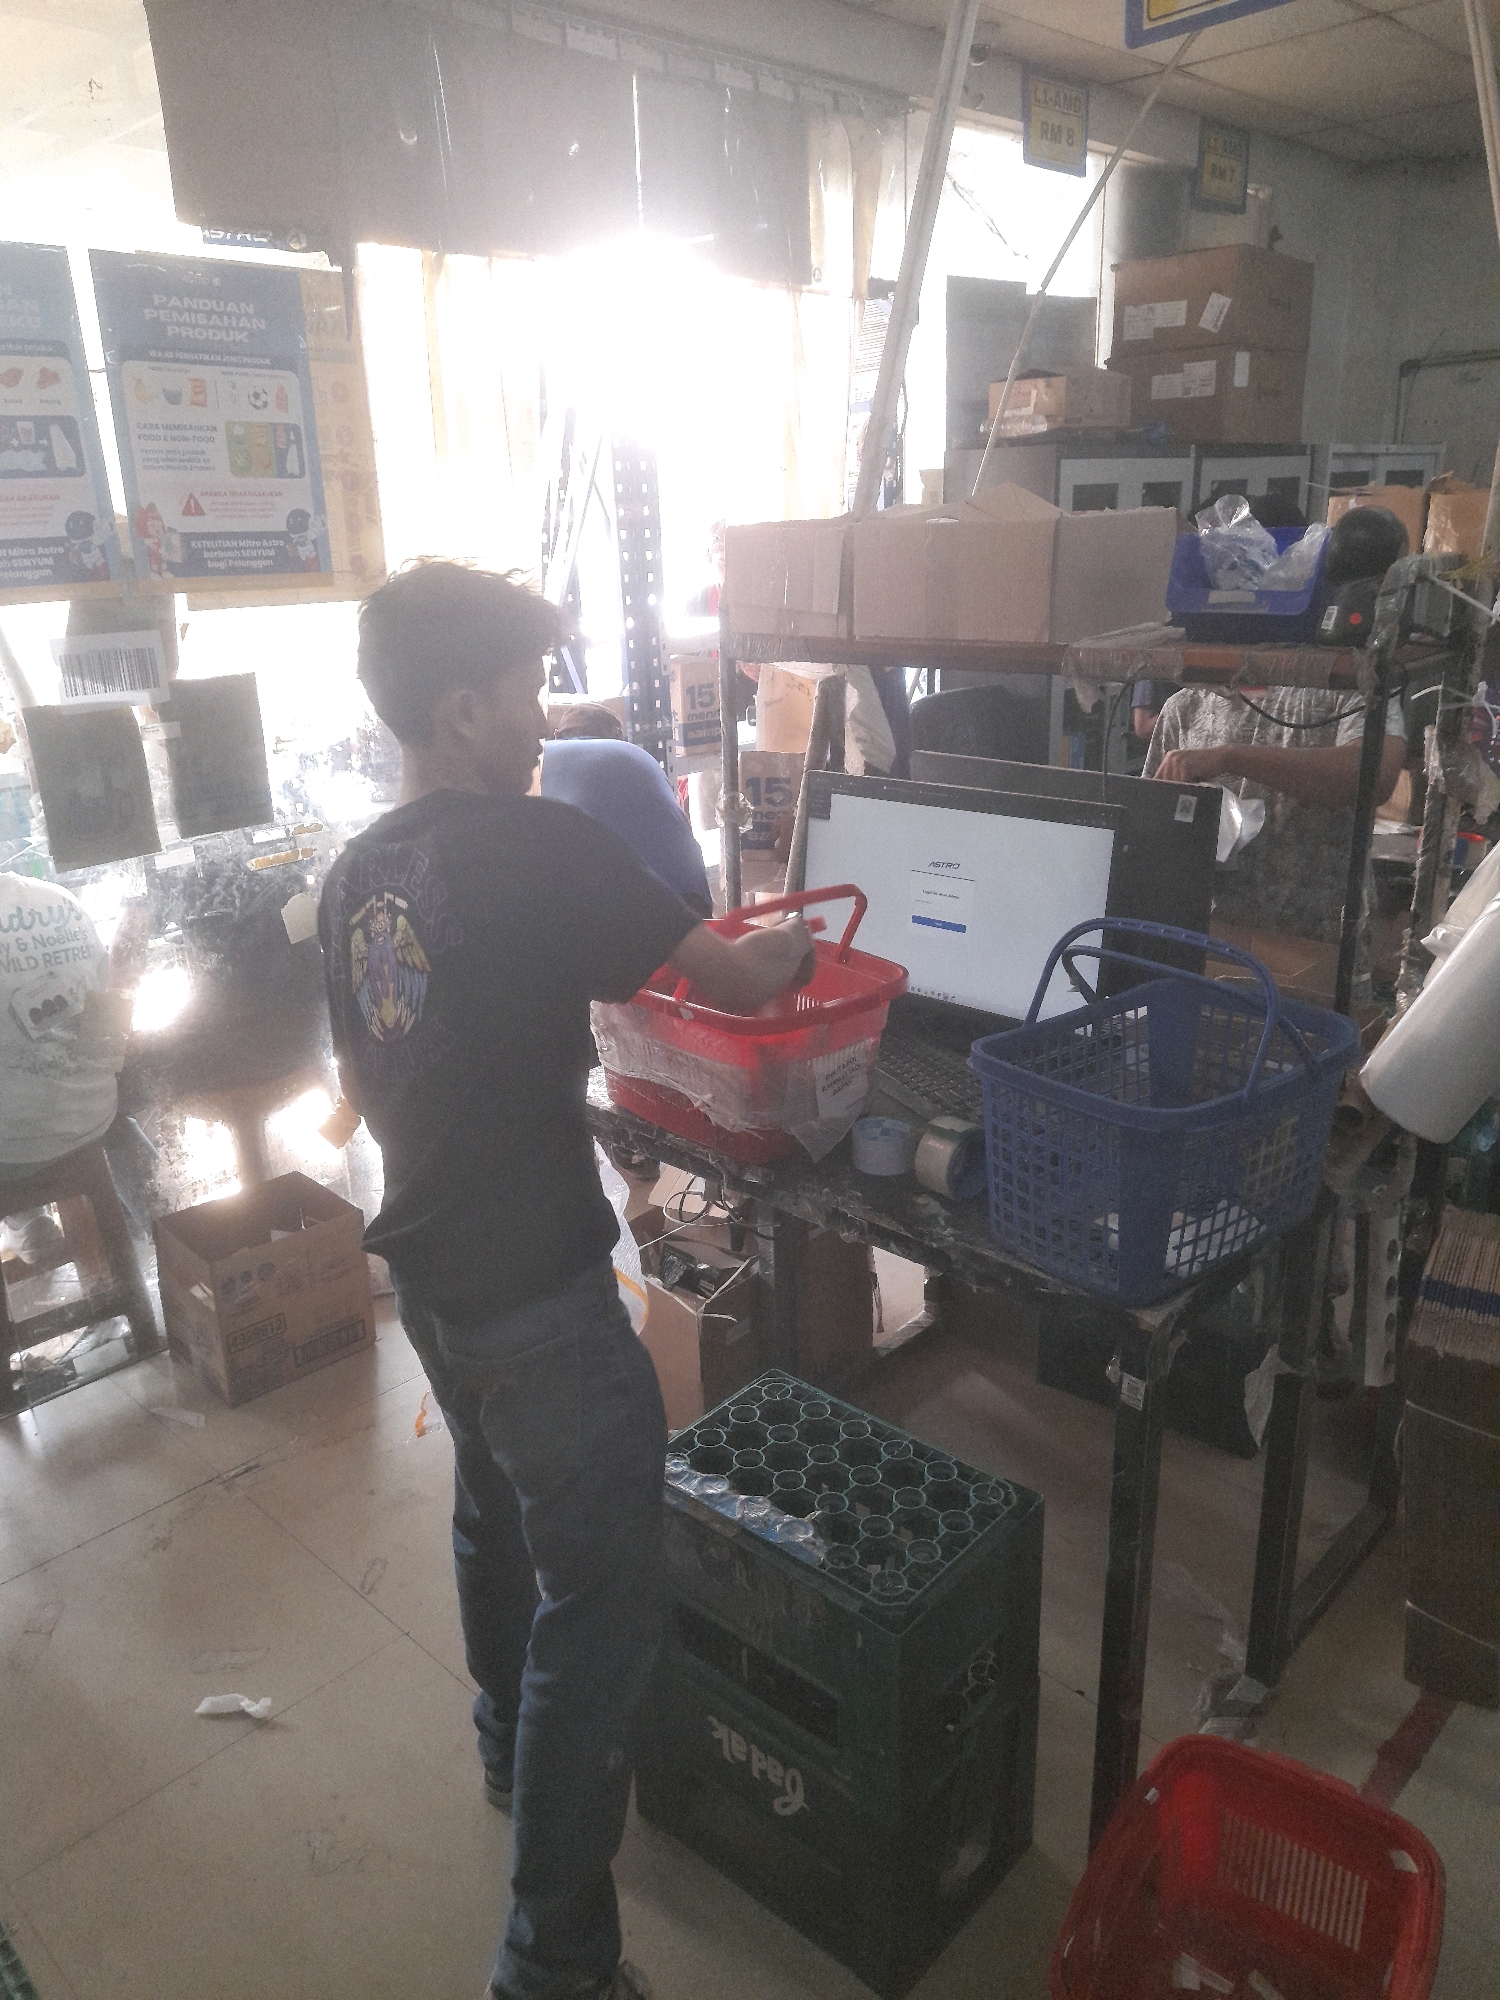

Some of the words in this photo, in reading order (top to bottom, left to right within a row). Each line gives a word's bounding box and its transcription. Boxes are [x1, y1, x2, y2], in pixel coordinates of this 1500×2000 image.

[1039, 121, 1062, 144] RM
[1065, 128, 1075, 146] 8
[152, 294, 255, 314] PANDUAN
[143, 308, 266, 330] PEMISAHAN
[166, 325, 250, 342] PRODUK
[136, 422, 160, 430] CARA
[137, 434, 161, 442] FOOD
[169, 435, 215, 443] NON-FOOD
[190, 540, 238, 549] KETELITIAN
[238, 539, 261, 548] Mitra
[262, 539, 285, 547] Astro
[8, 547, 36, 556] Mitra
[38, 546, 64, 554] Astro
[241, 549, 275, 557] SENYUM
[11, 557, 54, 567] SENYUM
[228, 560, 274, 569] Pelanggan
[685, 682, 716, 710] 15
[745, 776, 793, 807] 15
[928, 861, 960, 870] ASTRO
